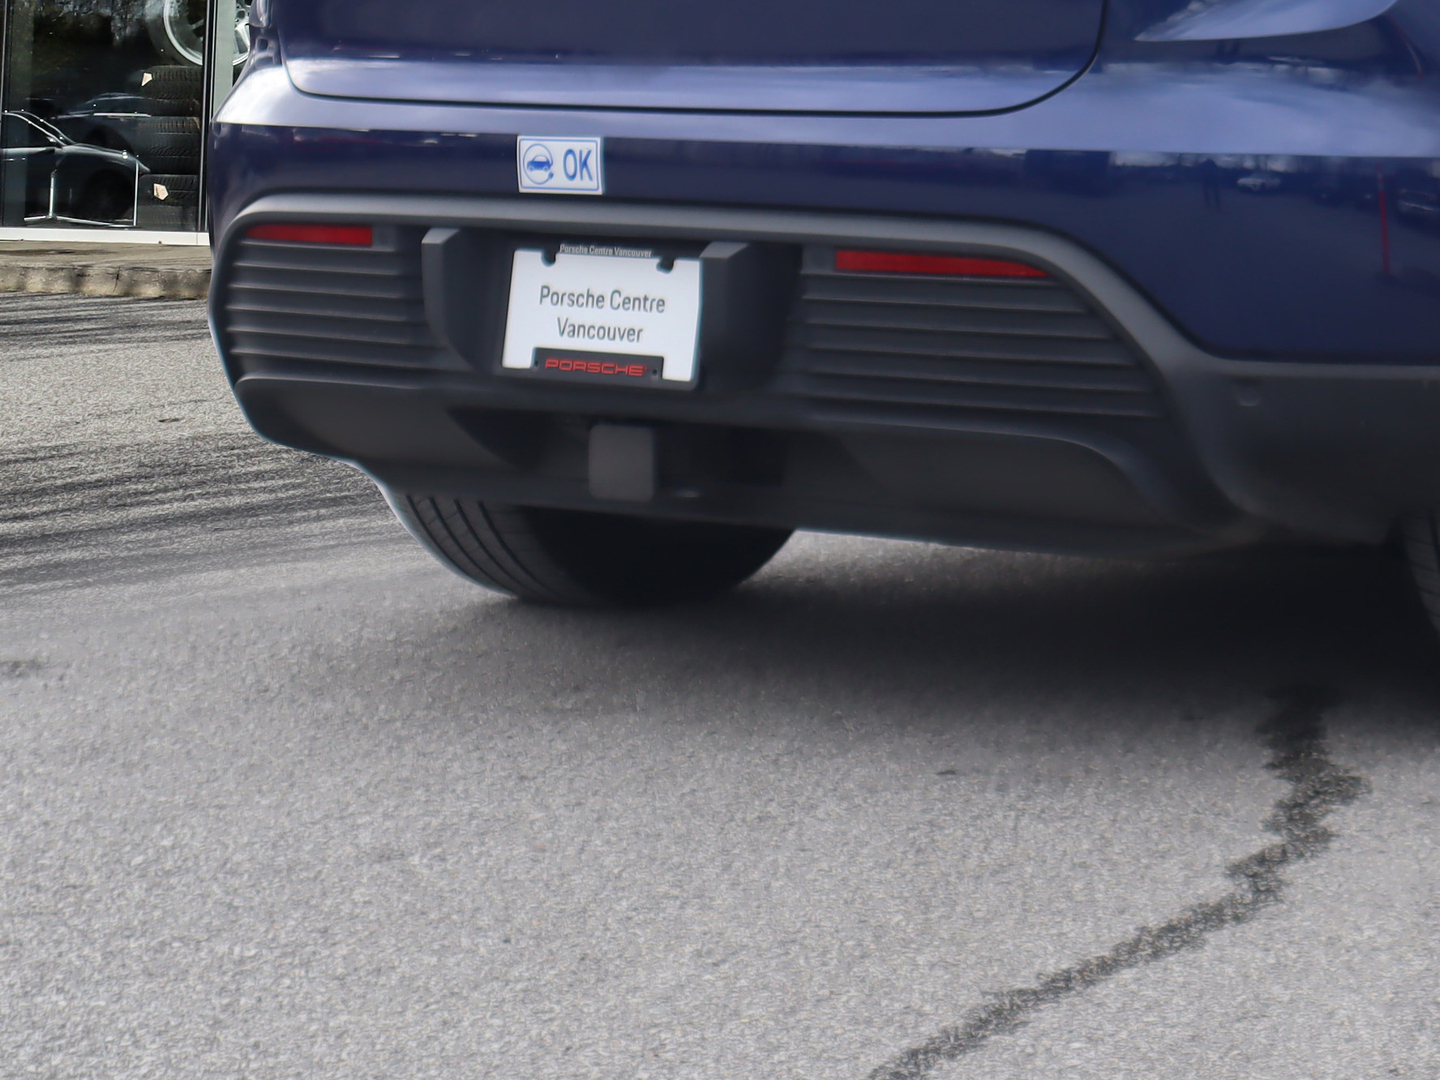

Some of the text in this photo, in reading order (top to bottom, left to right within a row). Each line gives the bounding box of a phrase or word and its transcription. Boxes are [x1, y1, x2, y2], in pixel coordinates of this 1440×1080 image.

[562, 147, 594, 183] OK
[559, 243, 652, 258] Porsche Centre Vancouver
[539, 284, 666, 314] Porsche Centre
[556, 316, 644, 344] Vancouver
[545, 358, 645, 377] PORSCHE
